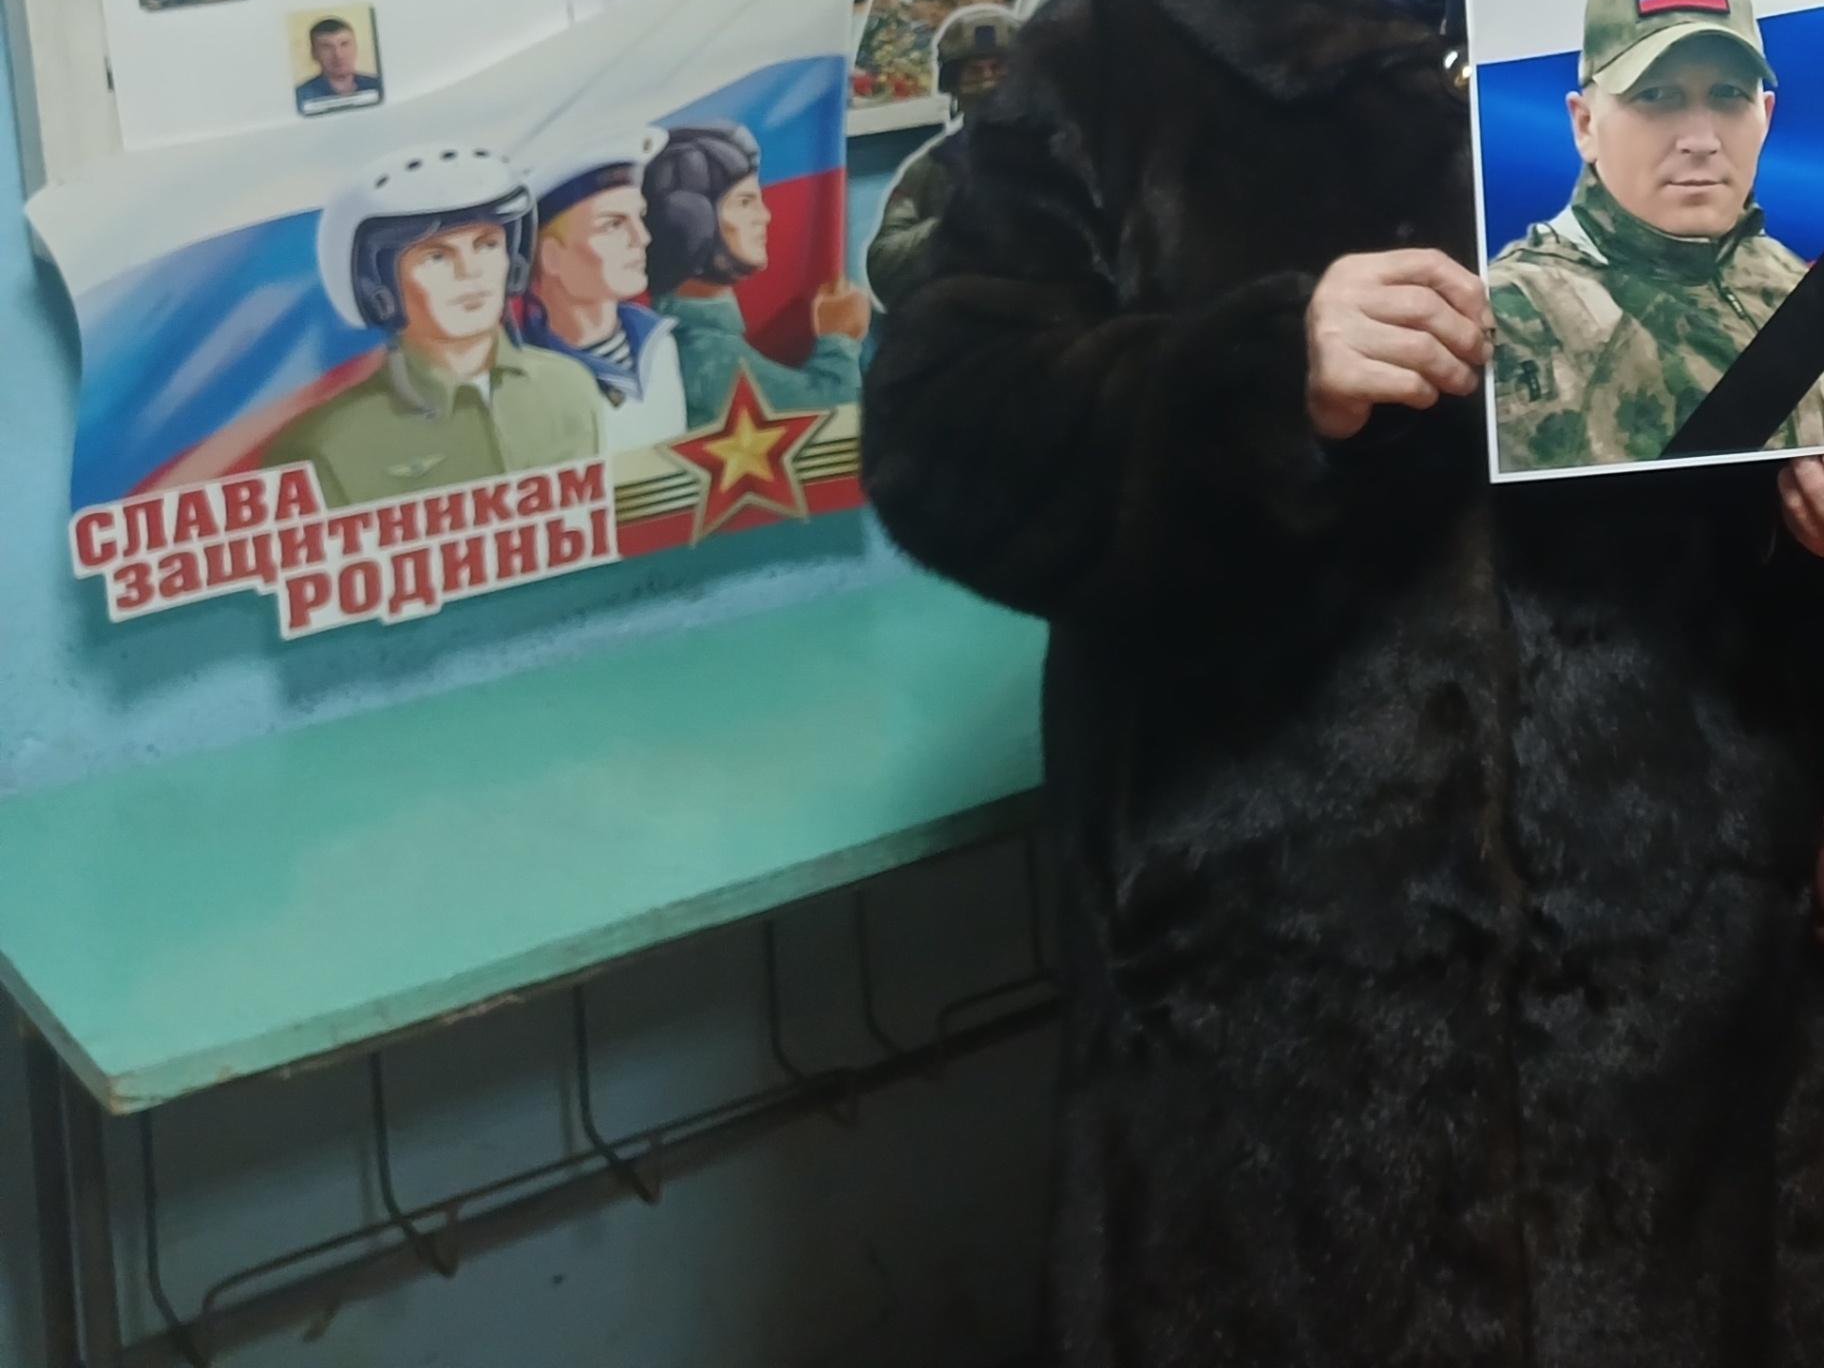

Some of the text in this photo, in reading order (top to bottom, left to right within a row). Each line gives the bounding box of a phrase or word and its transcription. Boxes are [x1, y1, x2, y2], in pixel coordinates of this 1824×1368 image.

[75, 468, 318, 568] СЛАВА
[112, 460, 607, 612] защитникам
[284, 506, 611, 630] РОДИНЫ
